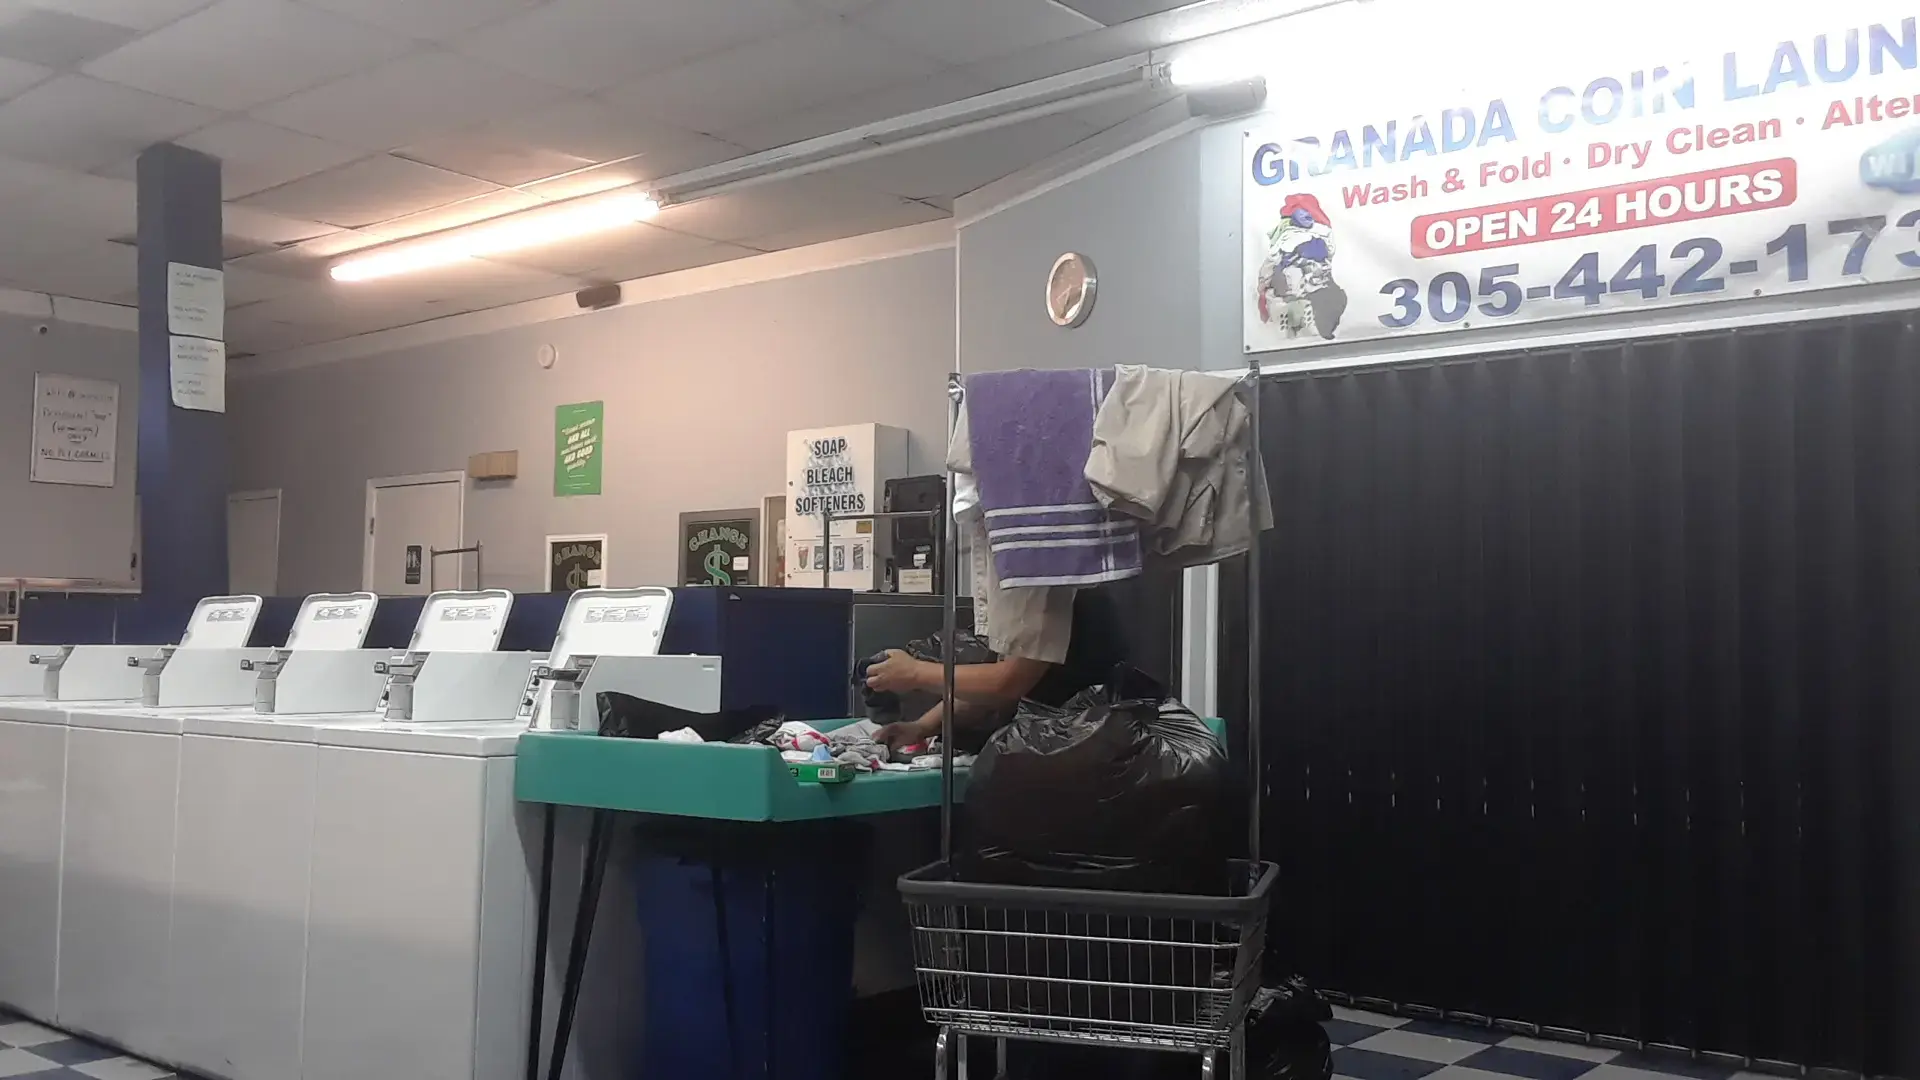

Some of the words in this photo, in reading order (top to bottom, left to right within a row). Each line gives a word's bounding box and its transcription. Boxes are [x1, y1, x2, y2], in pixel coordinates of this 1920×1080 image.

[1252, 98, 1517, 186] GRANADA
[1538, 61, 1695, 134] COIN
[1723, 16, 1919, 102] LAUN
[1342, 174, 1428, 209] Wash
[1441, 168, 1465, 193] &
[1479, 151, 1551, 188] Fold
[1587, 140, 1653, 169] Dry
[1666, 117, 1782, 155] Clean
[1425, 206, 1539, 251] OPEN
[1549, 201, 1602, 233] 24
[1616, 169, 1784, 224] HOURS
[814, 438, 847, 458] SOAP
[807, 467, 853, 486] BLEACH
[796, 494, 866, 515] SOFTENERS
[689, 526, 748, 551] CHANGE
[554, 544, 601, 566] CHANGE
